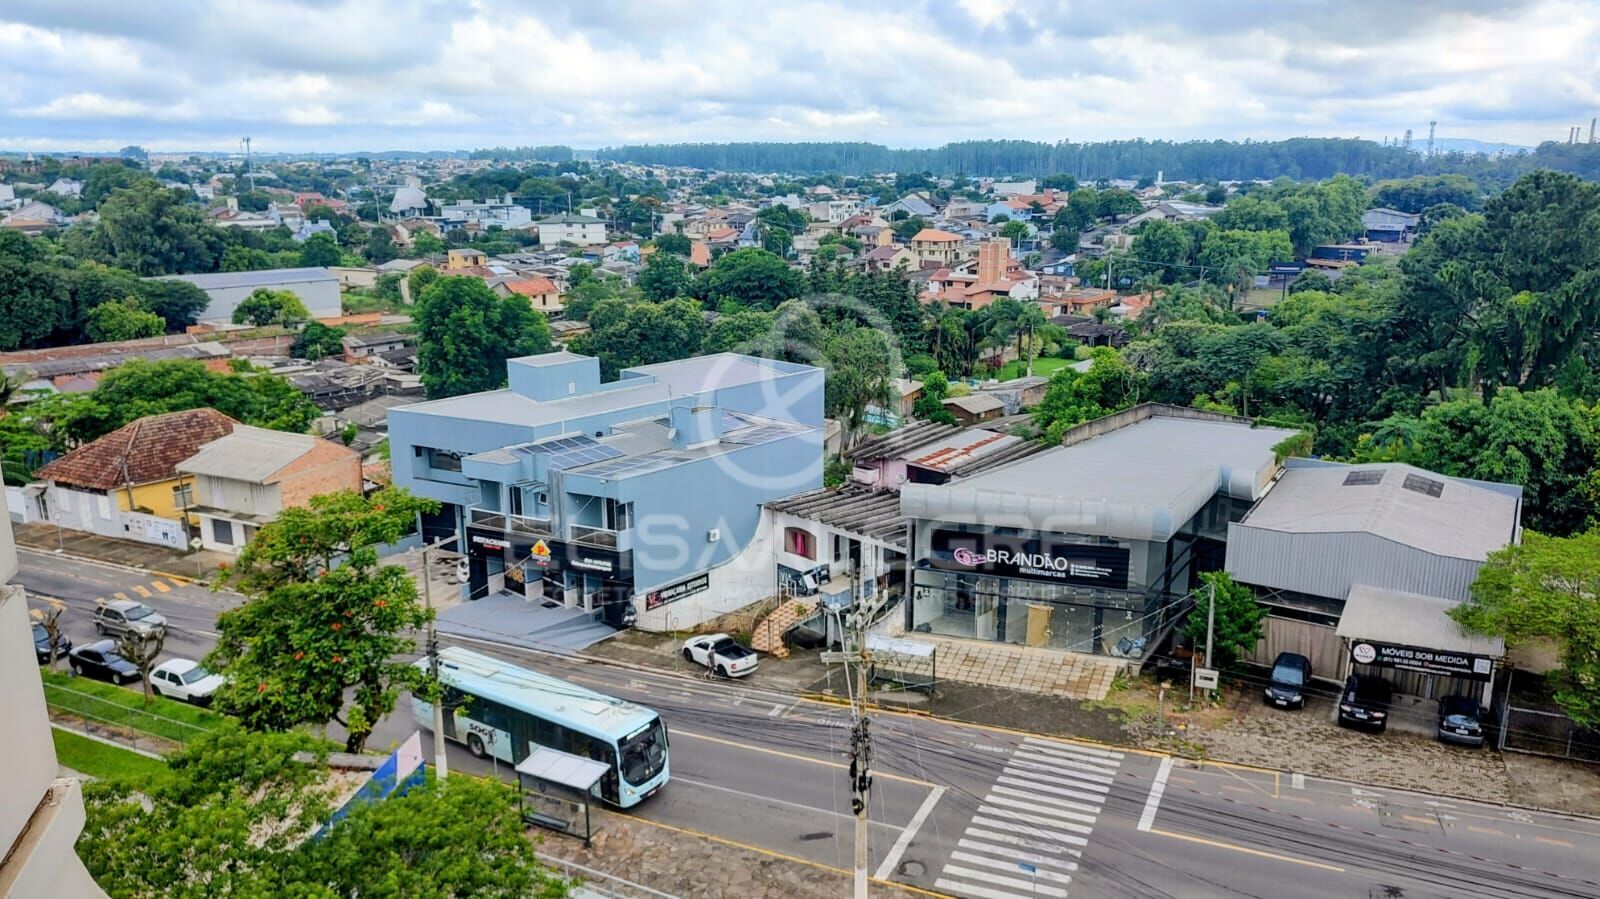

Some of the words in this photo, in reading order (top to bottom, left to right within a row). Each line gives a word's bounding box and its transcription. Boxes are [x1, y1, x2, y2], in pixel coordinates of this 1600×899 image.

[986, 549, 1068, 571] BRANDÃO
[1019, 566, 1066, 578] multimarcas
[1381, 647, 1414, 658] MÓVEIS
[1414, 651, 1433, 661] SOB
[1435, 655, 1469, 666] MEDIDA
